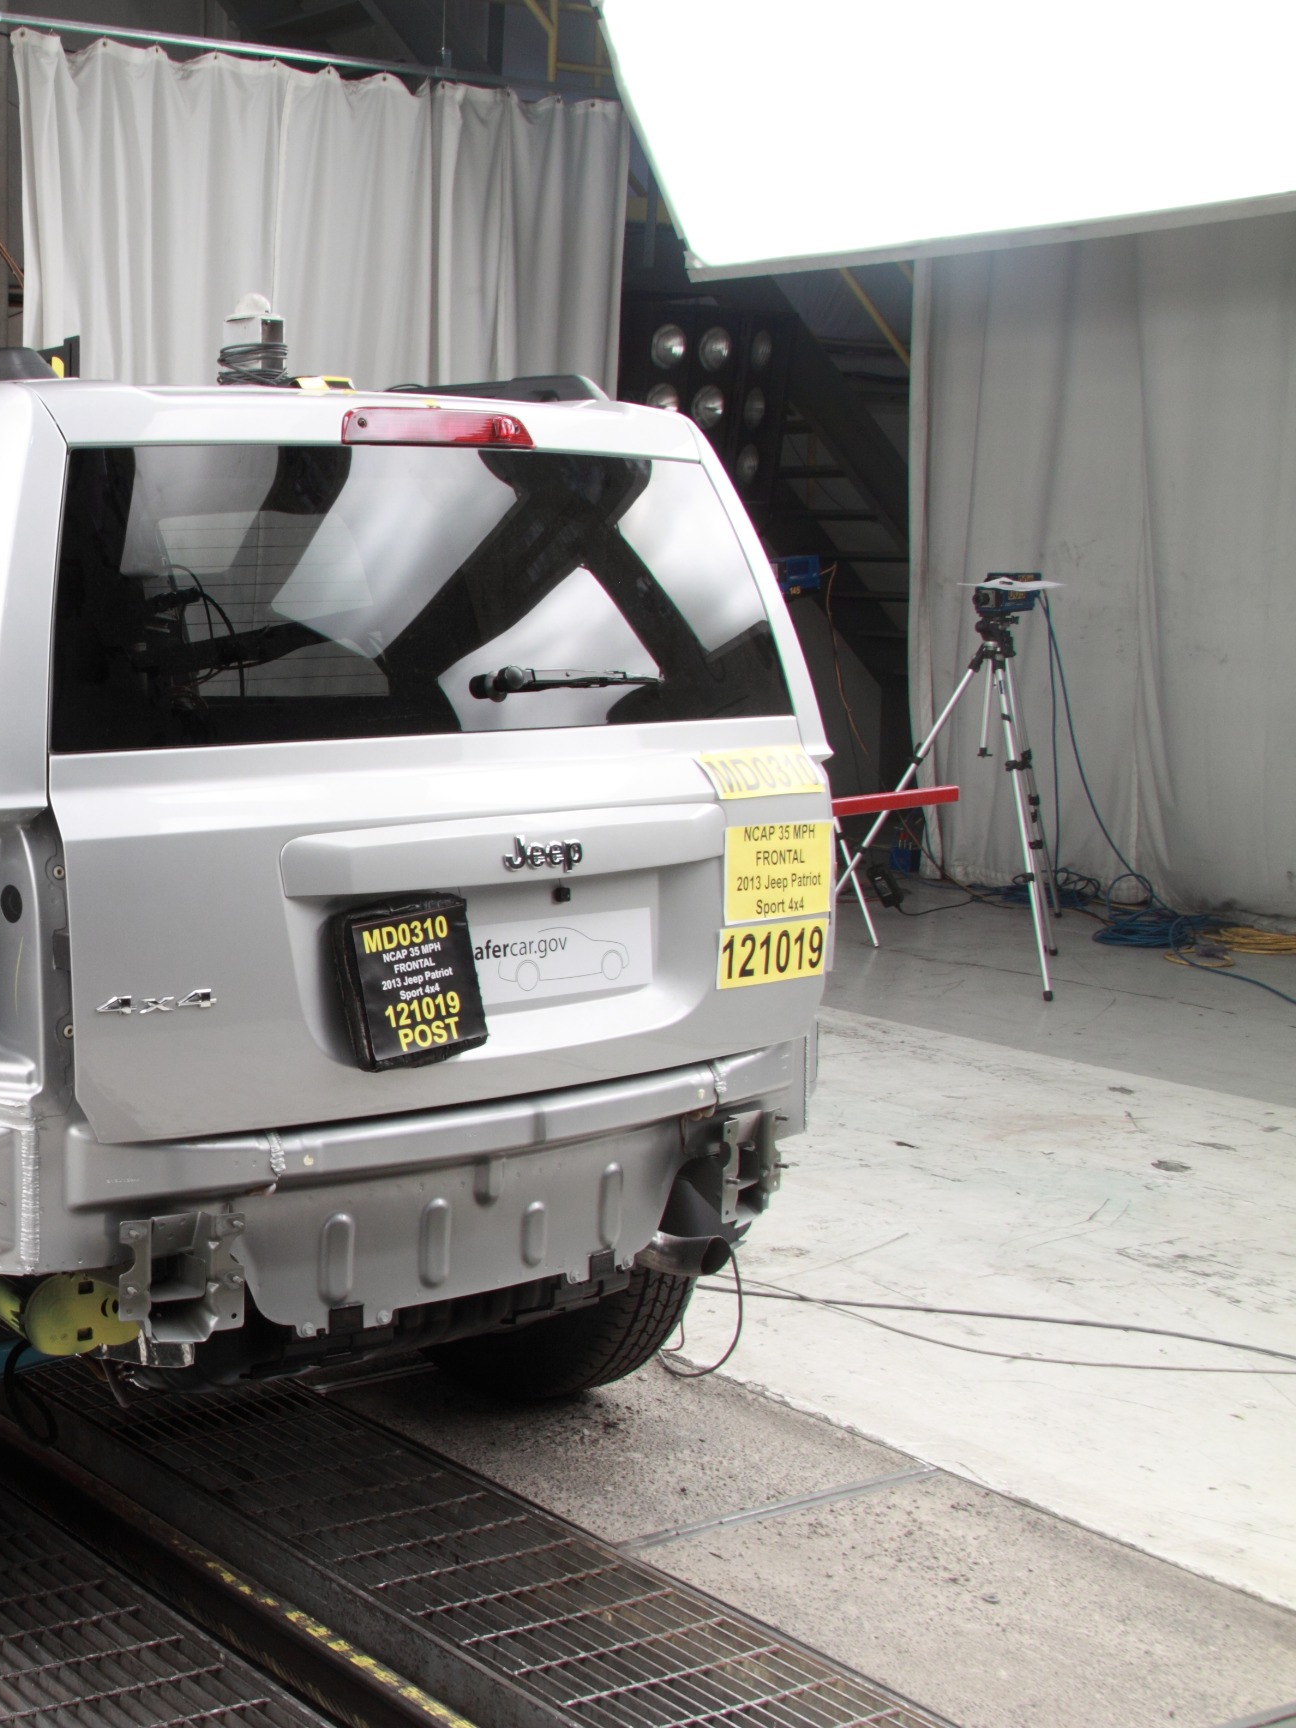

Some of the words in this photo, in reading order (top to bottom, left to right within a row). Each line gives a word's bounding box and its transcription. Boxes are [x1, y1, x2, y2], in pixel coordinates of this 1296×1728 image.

[706, 753, 821, 795] MD0310
[743, 825, 776, 843] NCAP
[778, 824, 791, 841] 35
[792, 823, 816, 841] MPH
[502, 834, 583, 873] Jeep
[755, 848, 806, 867] FRONTAL
[736, 874, 762, 892] 2013
[764, 873, 789, 894] Jeep
[790, 871, 822, 889] Patriot
[755, 898, 786, 918] Sport
[787, 896, 805, 913] 4x4
[362, 915, 449, 954] MD0310
[382, 948, 408, 963] NCAP
[409, 946, 421, 957] 35
[421, 941, 442, 955] MPH
[473, 936, 568, 961] afercar.gov
[721, 925, 824, 980] 121019
[393, 957, 436, 974] FRONTAL
[381, 978, 402, 991] 2013
[403, 973, 424, 987] Jeep
[424, 966, 454, 982] Patriot
[399, 986, 424, 1001] Sport
[424, 982, 441, 995] 4x4
[384, 991, 461, 1028] 121019
[398, 1016, 459, 1052] POST
